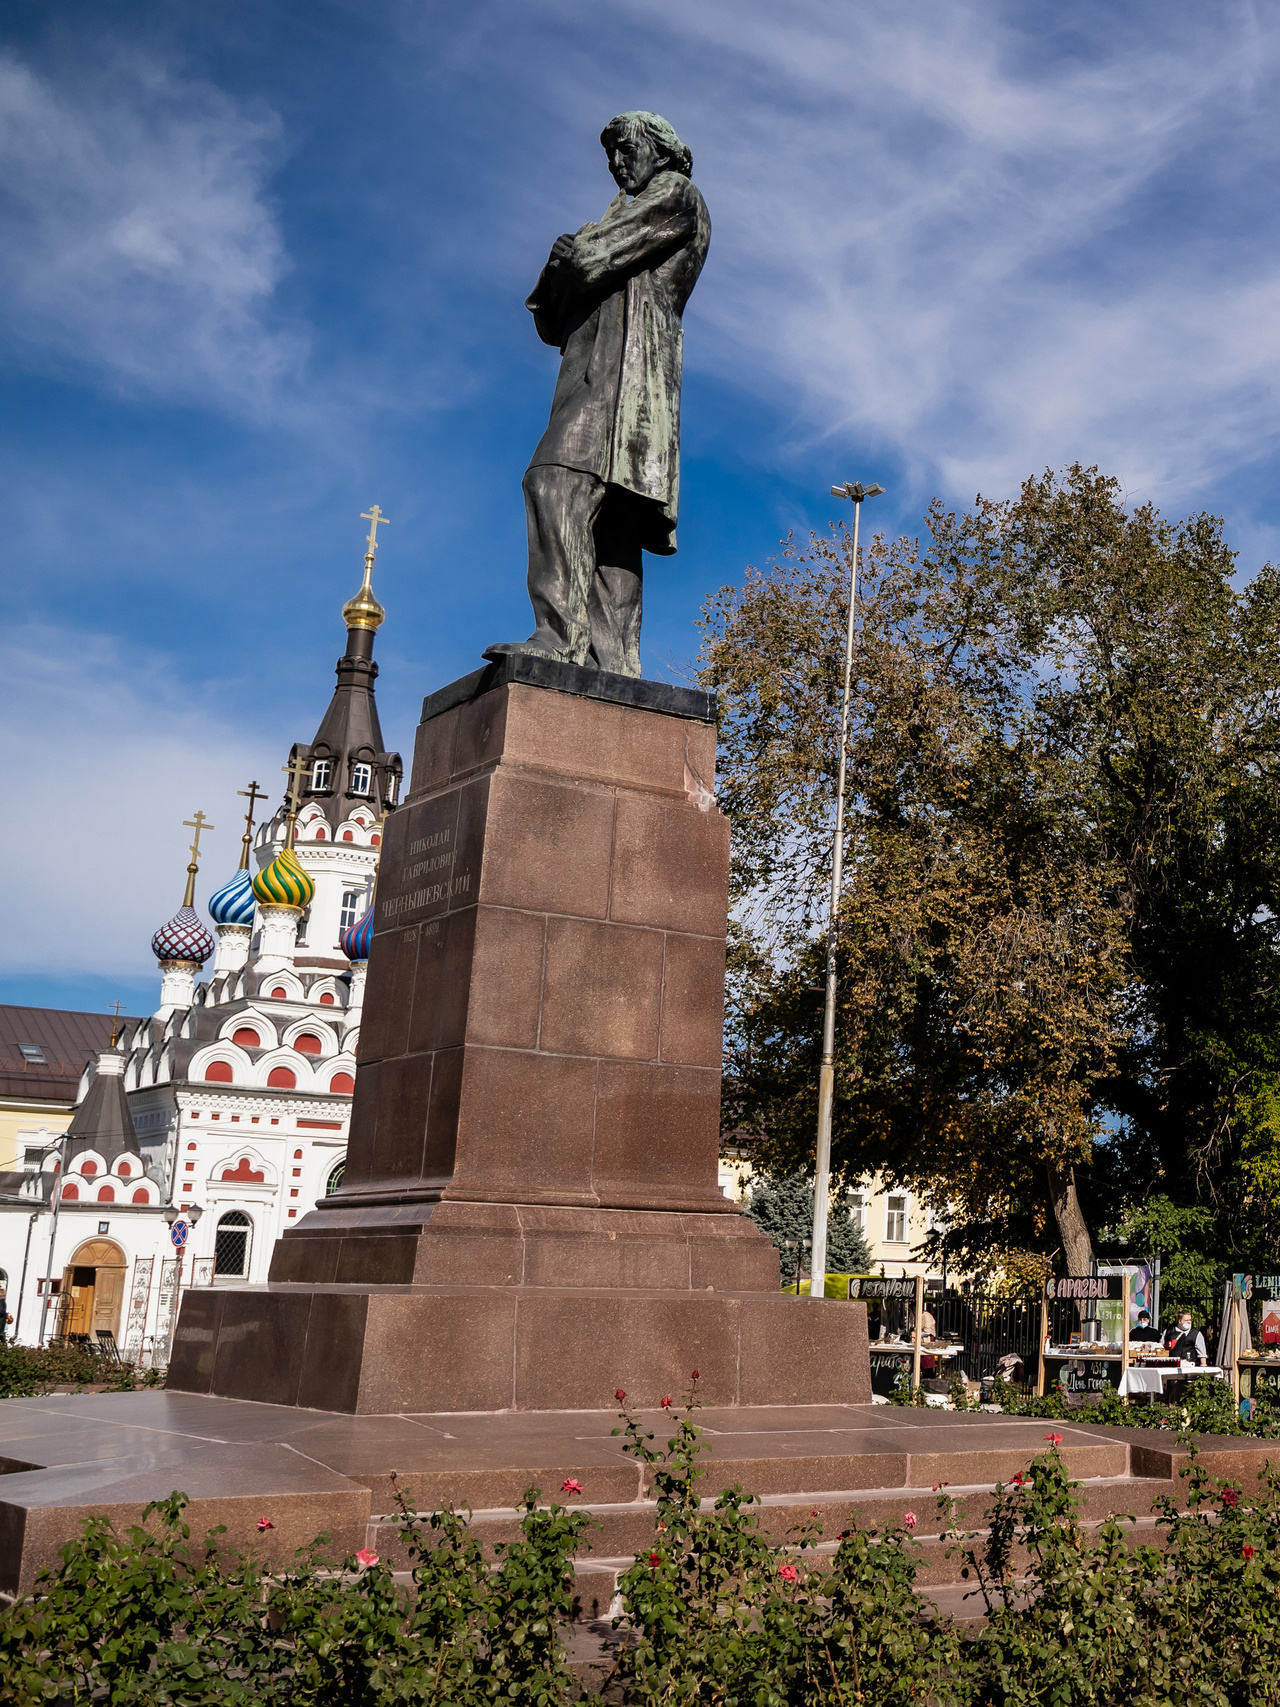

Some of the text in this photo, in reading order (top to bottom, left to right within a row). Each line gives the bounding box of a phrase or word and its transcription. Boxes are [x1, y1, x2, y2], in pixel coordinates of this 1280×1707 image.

[410, 825, 451, 855] НИКОЛАЙ
[402, 851, 458, 881] ГАВРИЛОВИЧ
[382, 867, 472, 917] ЧЕРНЫШЕВСКИЙ
[870, 1354, 911, 1377] аратов
